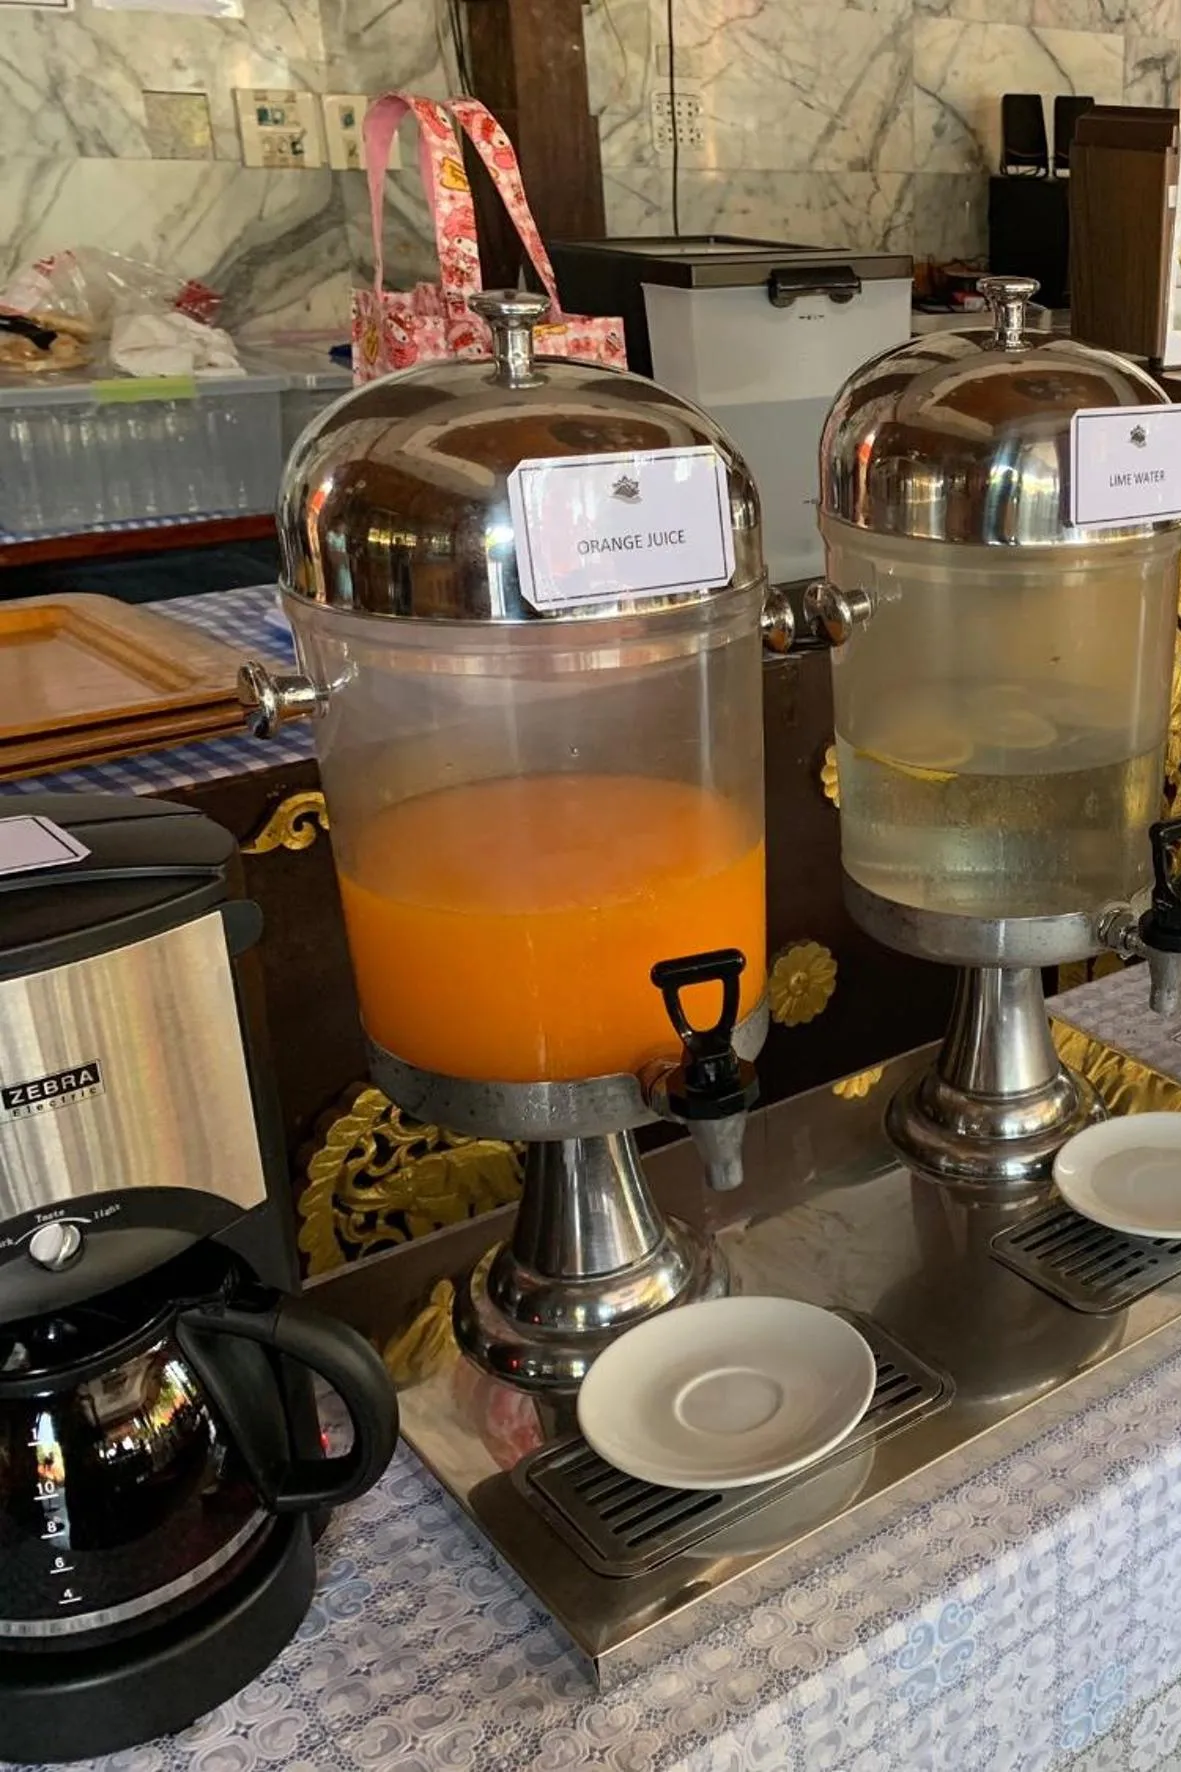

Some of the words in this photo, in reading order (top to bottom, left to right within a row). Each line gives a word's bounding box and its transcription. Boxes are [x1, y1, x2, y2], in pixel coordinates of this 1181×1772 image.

[1109, 473, 1132, 487] LIME
[1133, 470, 1165, 484] WATER
[577, 534, 643, 555] ORANGE
[647, 529, 686, 549] JUICE
[8, 1070, 94, 1105] ZEBRA
[12, 1086, 97, 1118] Electric
[36, 1481, 55, 1495] 10
[47, 1521, 57, 1533] 8
[54, 1557, 65, 1568] 6
[63, 1588, 73, 1599] 4
